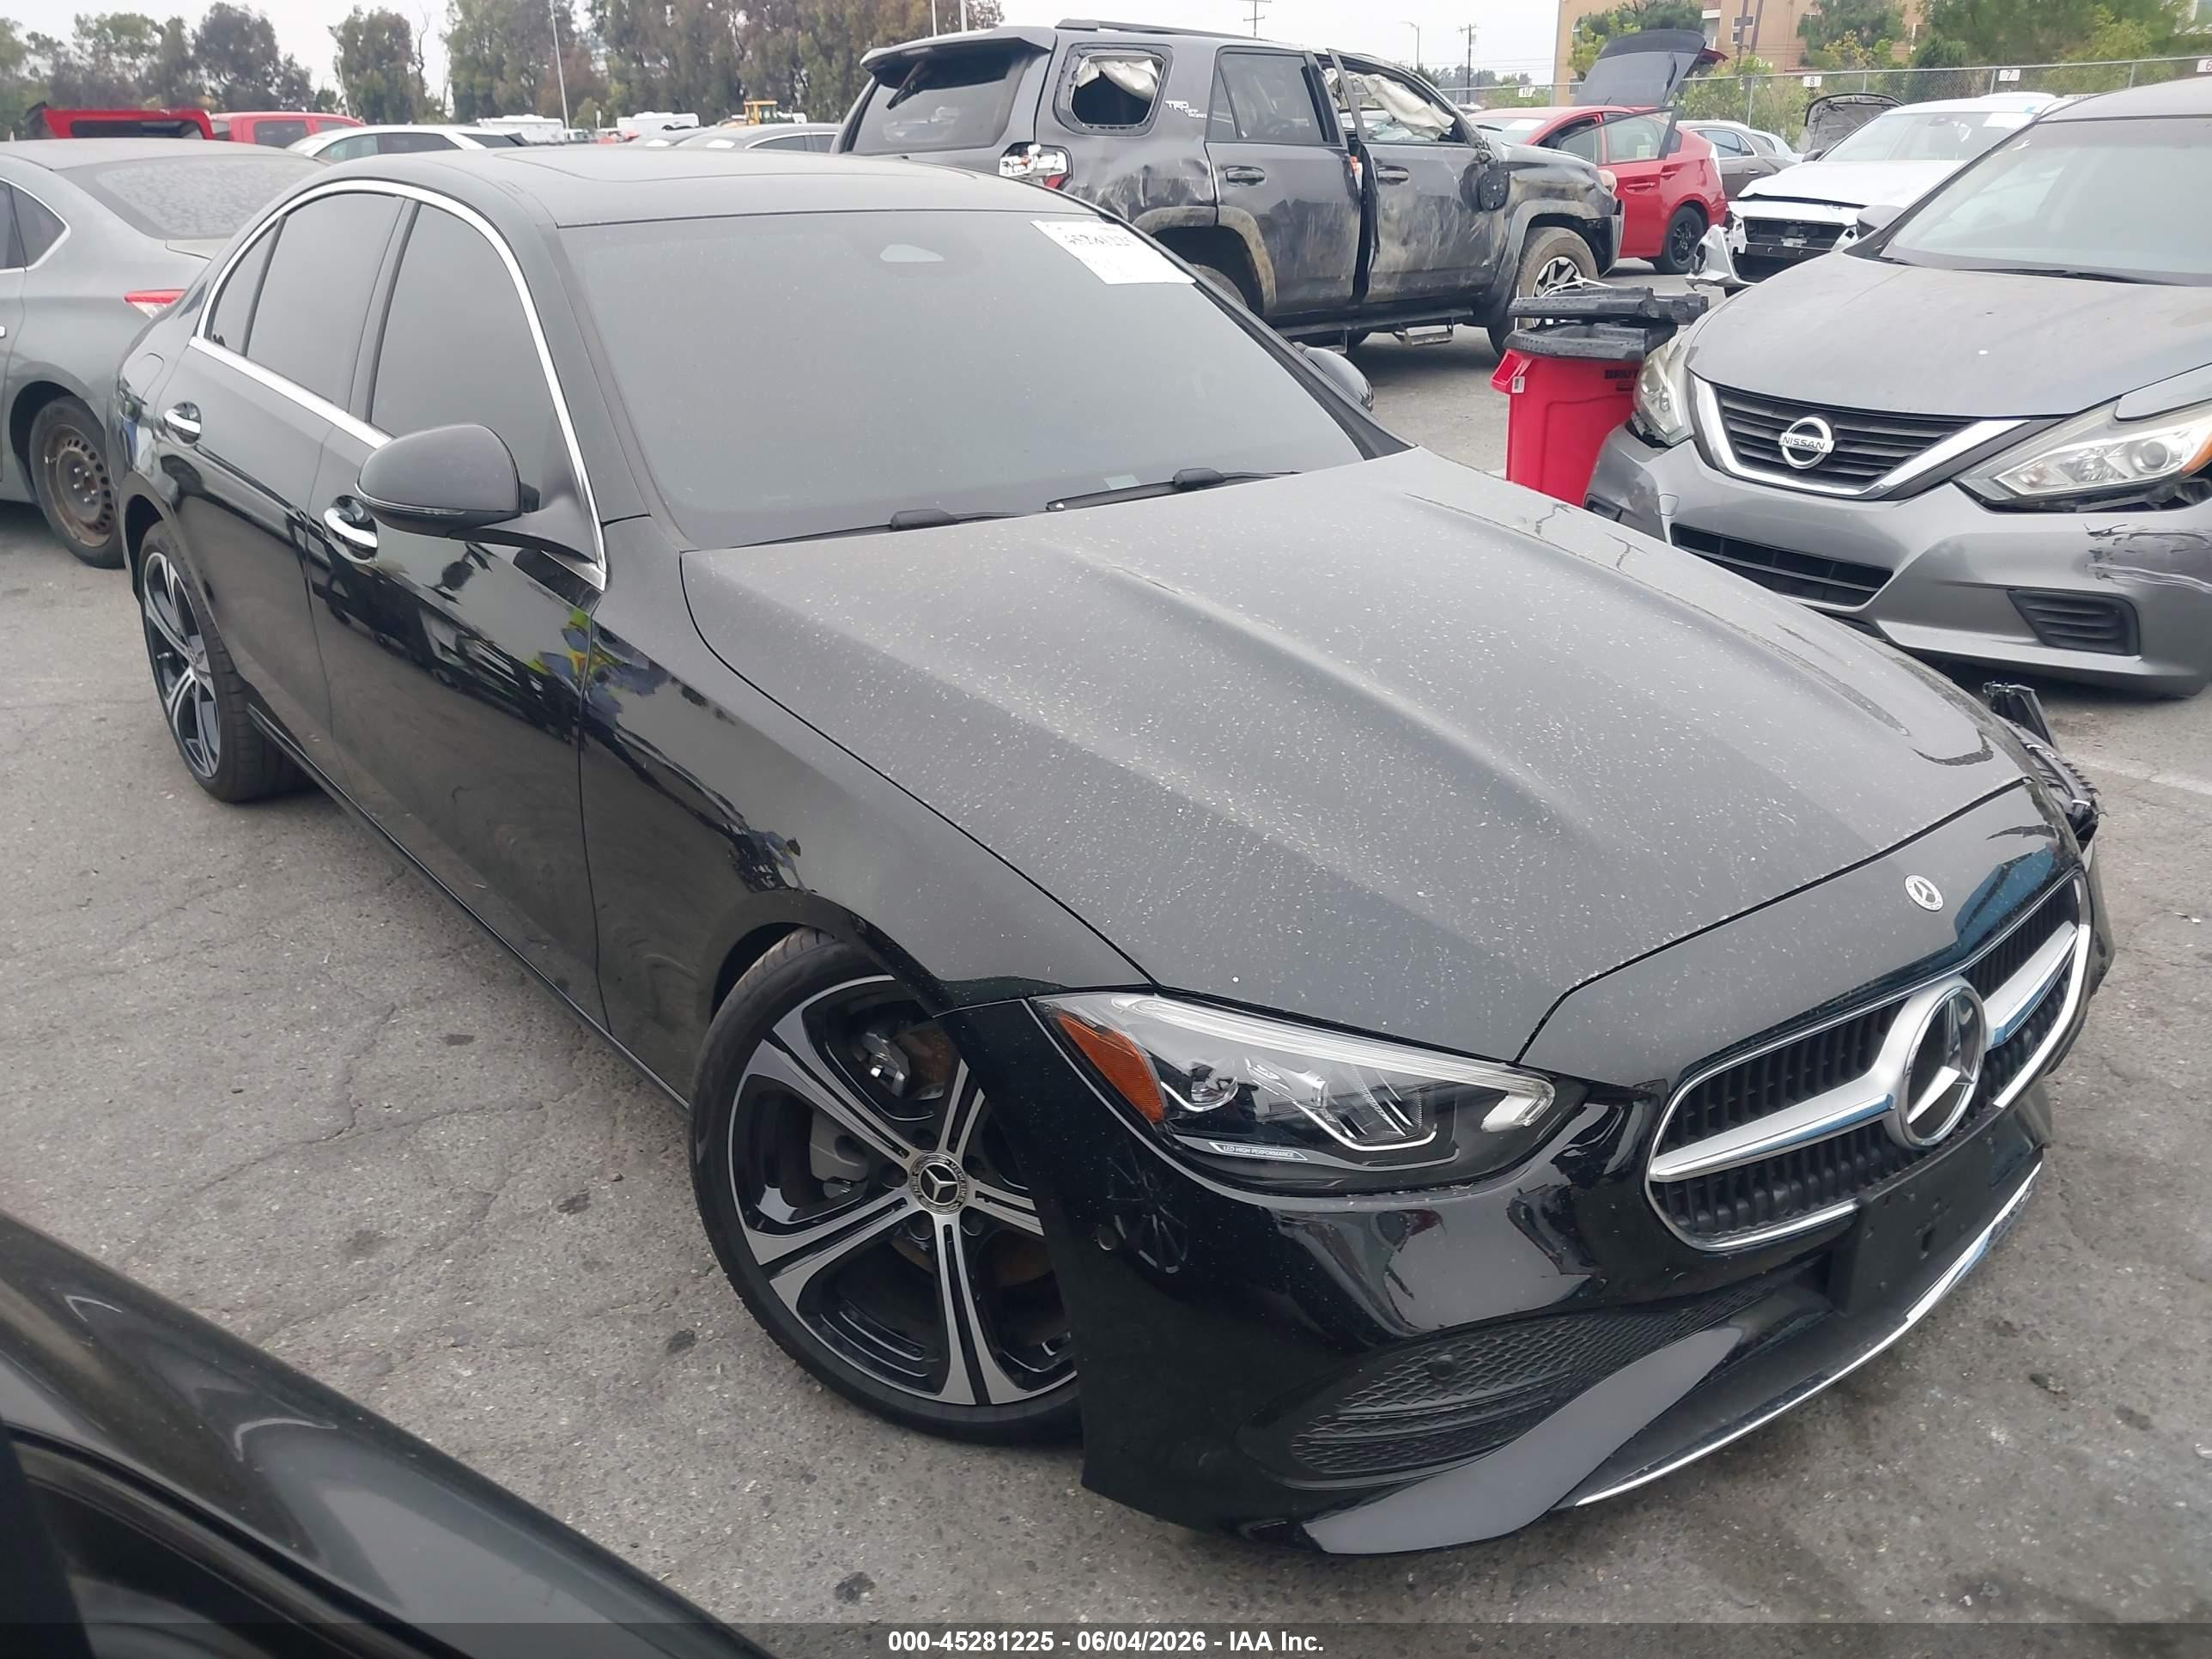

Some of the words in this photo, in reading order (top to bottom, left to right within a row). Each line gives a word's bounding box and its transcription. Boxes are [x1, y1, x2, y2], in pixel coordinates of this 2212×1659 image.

[2205, 60, 2212, 71] 6
[2007, 70, 2014, 80] 7
[1809, 76, 1815, 86] 8
[1165, 100, 1189, 110] TRD
[1783, 436, 1826, 450] NISSAN
